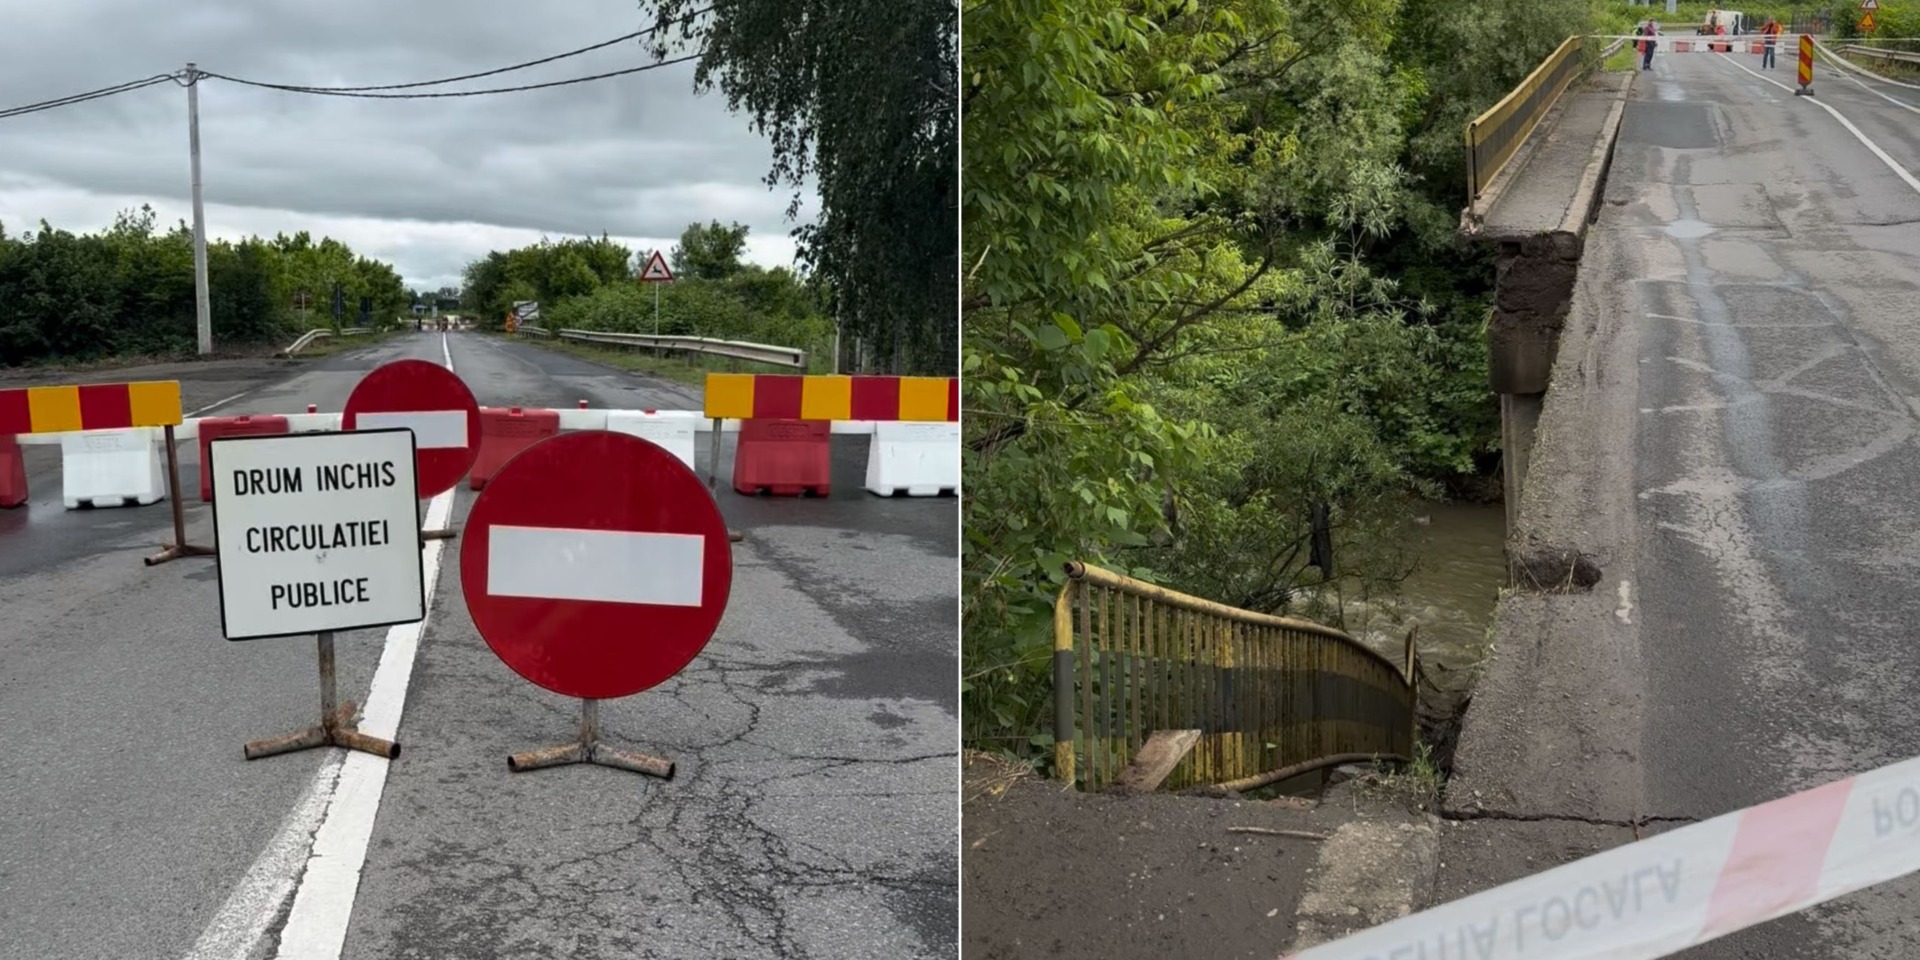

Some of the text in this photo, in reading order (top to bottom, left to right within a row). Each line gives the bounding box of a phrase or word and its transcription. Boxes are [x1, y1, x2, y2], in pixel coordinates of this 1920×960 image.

[233, 461, 396, 496] DRUM INCHIS
[246, 519, 389, 553] CIRCULATIEI
[270, 577, 370, 610] PUBLICE
